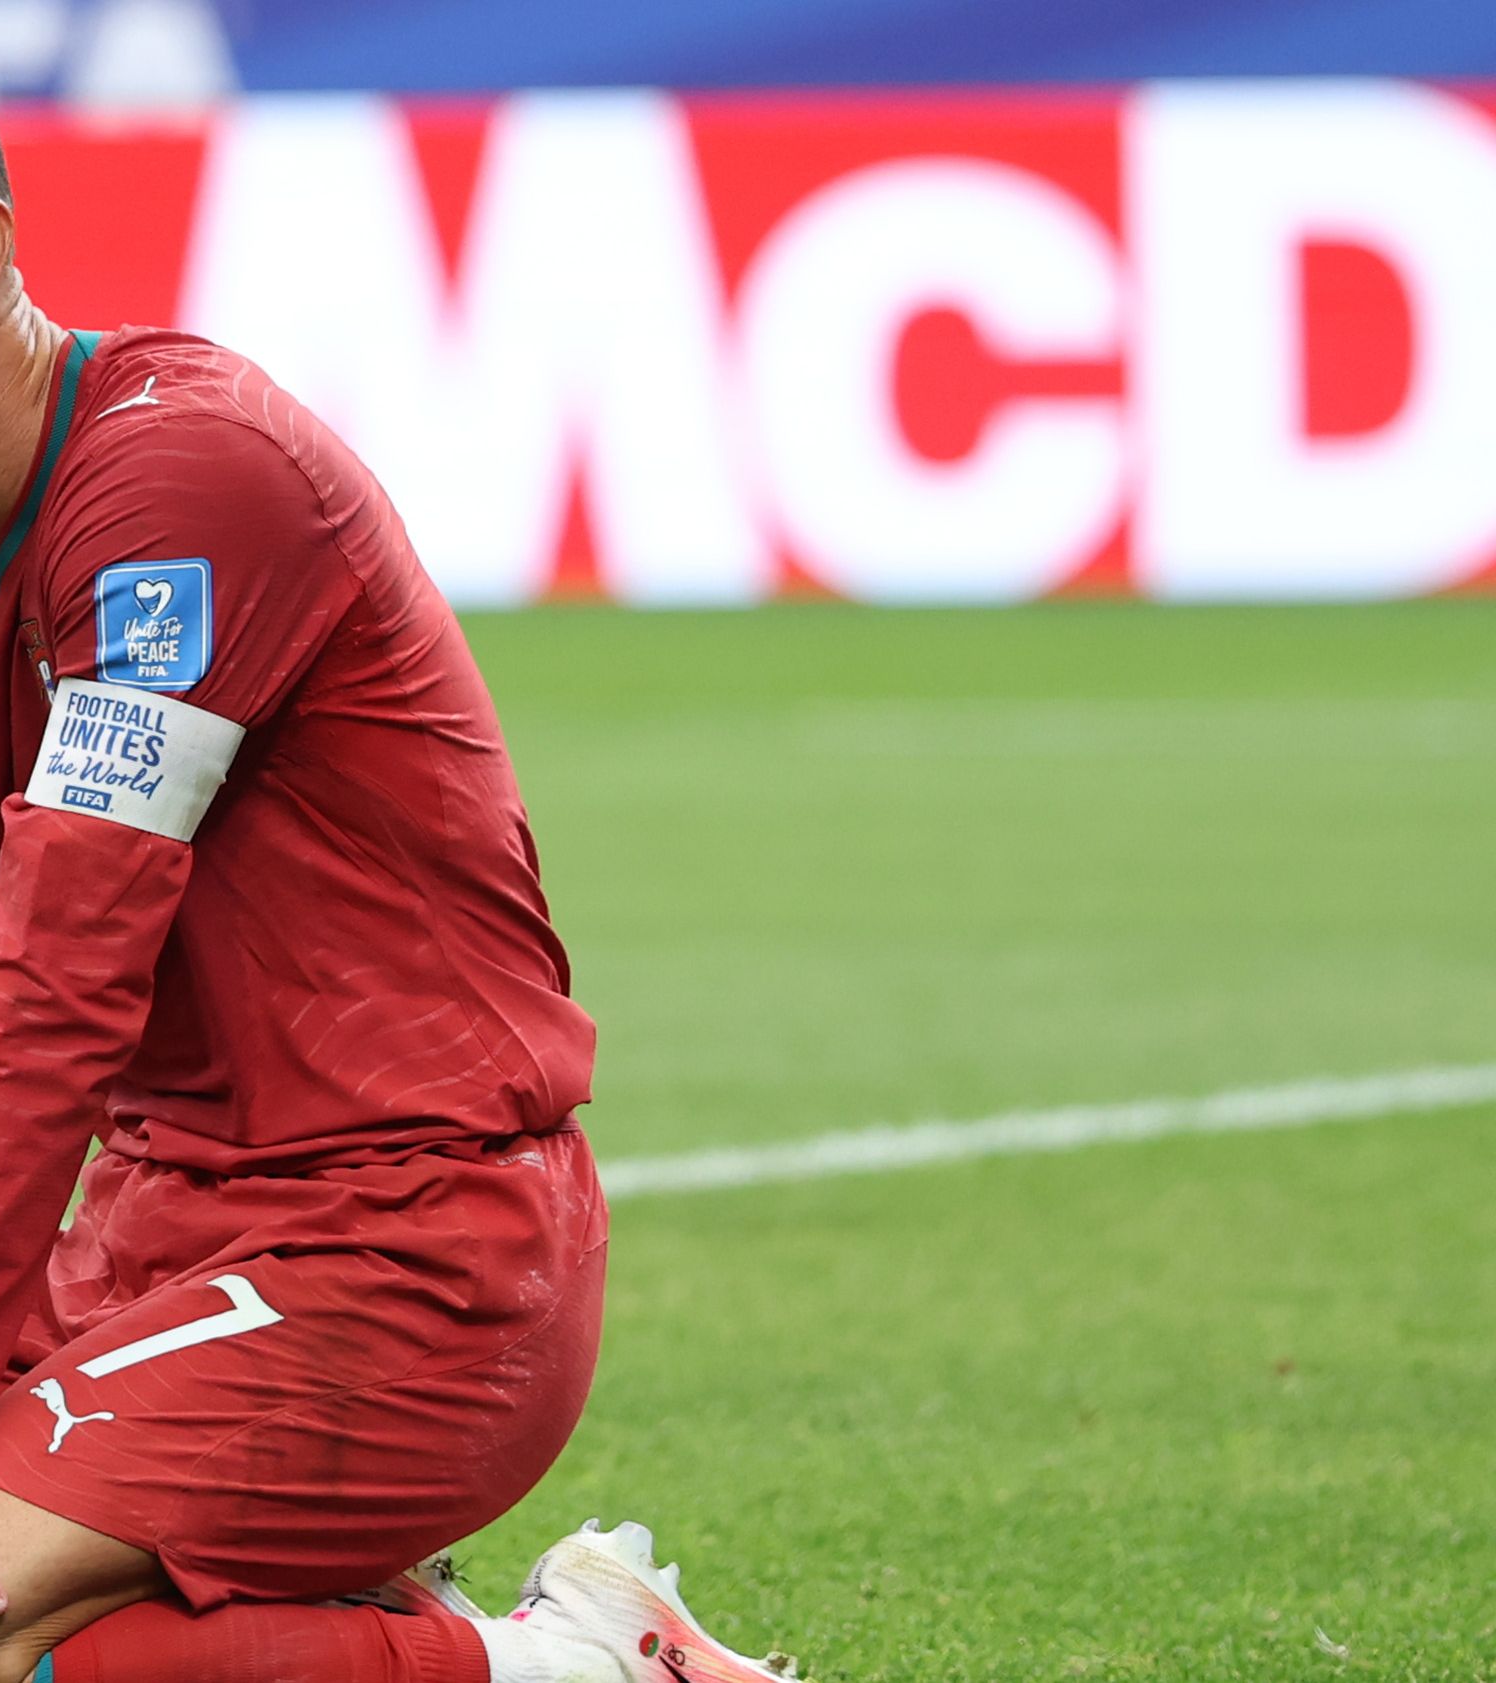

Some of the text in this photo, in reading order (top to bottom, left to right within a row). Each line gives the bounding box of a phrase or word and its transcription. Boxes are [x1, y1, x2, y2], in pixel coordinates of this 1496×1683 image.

[124, 616, 184, 642] Unite For
[127, 640, 180, 662] PEACE
[137, 665, 168, 677] FIFA
[67, 692, 166, 735] FOOTBALL
[59, 716, 165, 767] UNITES
[46, 750, 164, 800] the World
[65, 788, 106, 809] FIFA
[75, 1273, 285, 1380] 7
